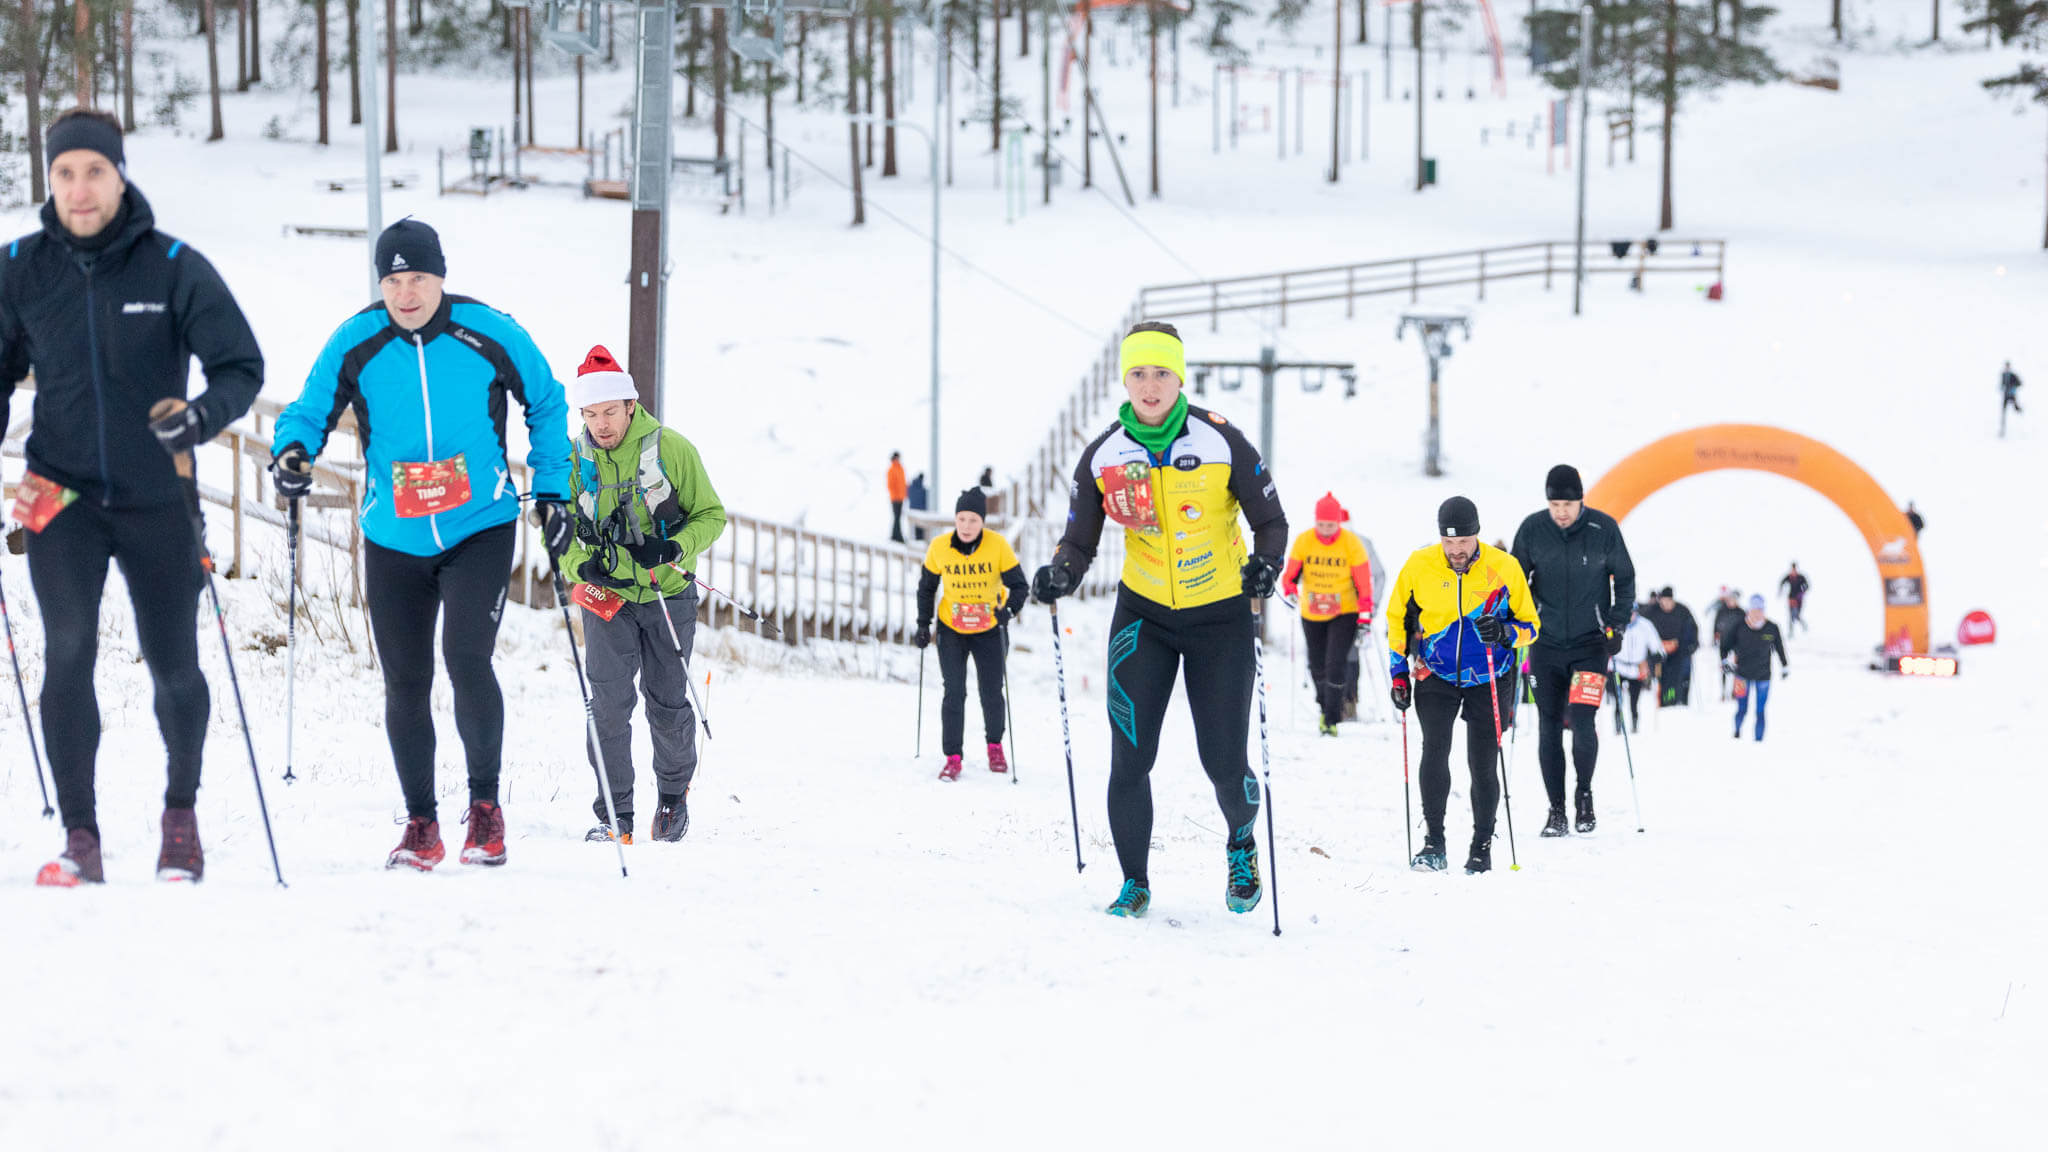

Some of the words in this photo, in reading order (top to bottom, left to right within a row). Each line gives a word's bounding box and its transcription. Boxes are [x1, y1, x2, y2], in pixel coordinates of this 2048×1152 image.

[416, 486, 446, 501] TIMO
[944, 561, 993, 575] KAIKKI
[584, 584, 605, 601] EERO
